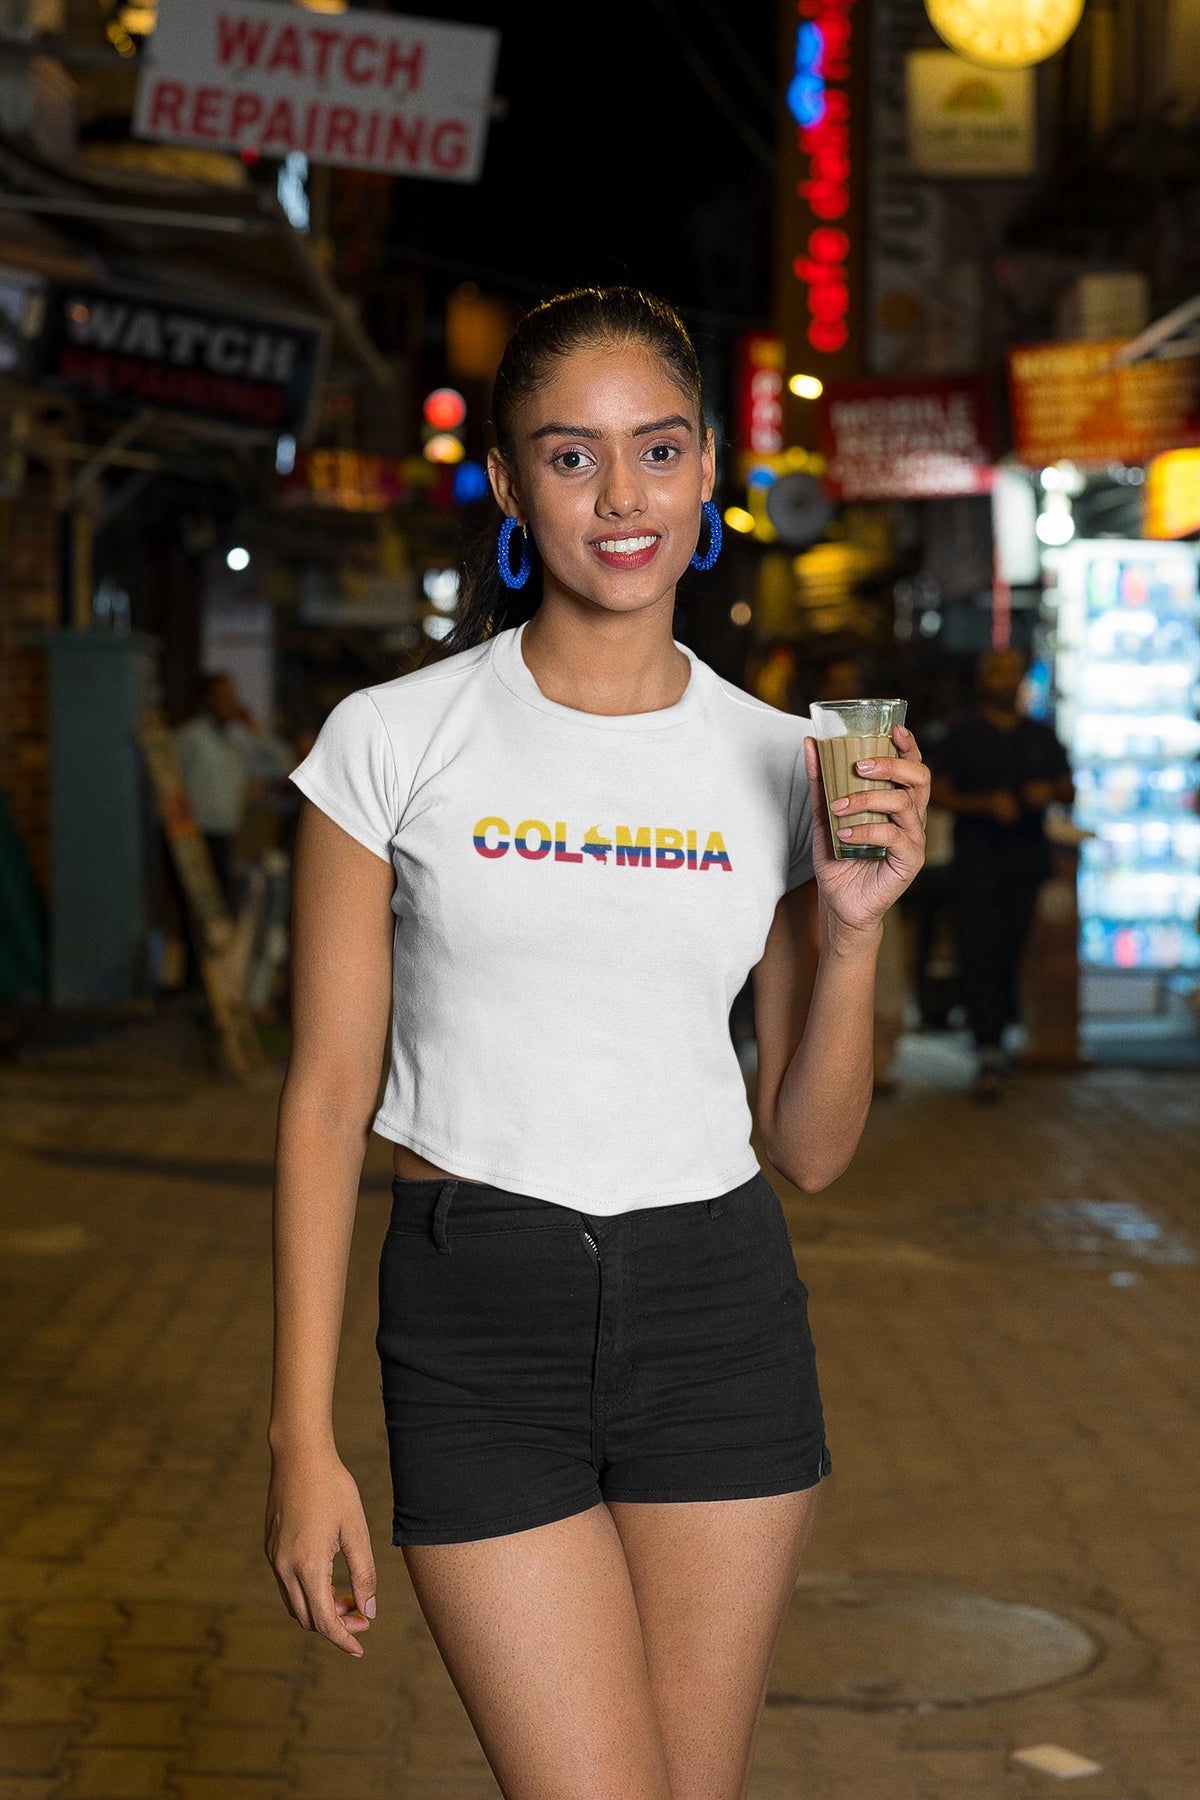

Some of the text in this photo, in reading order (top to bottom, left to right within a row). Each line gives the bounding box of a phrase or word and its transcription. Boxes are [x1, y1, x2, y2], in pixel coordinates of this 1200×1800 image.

[217, 14, 424, 92] WATCH
[151, 80, 468, 172] REPAIRING
[68, 302, 295, 383] WATCH
